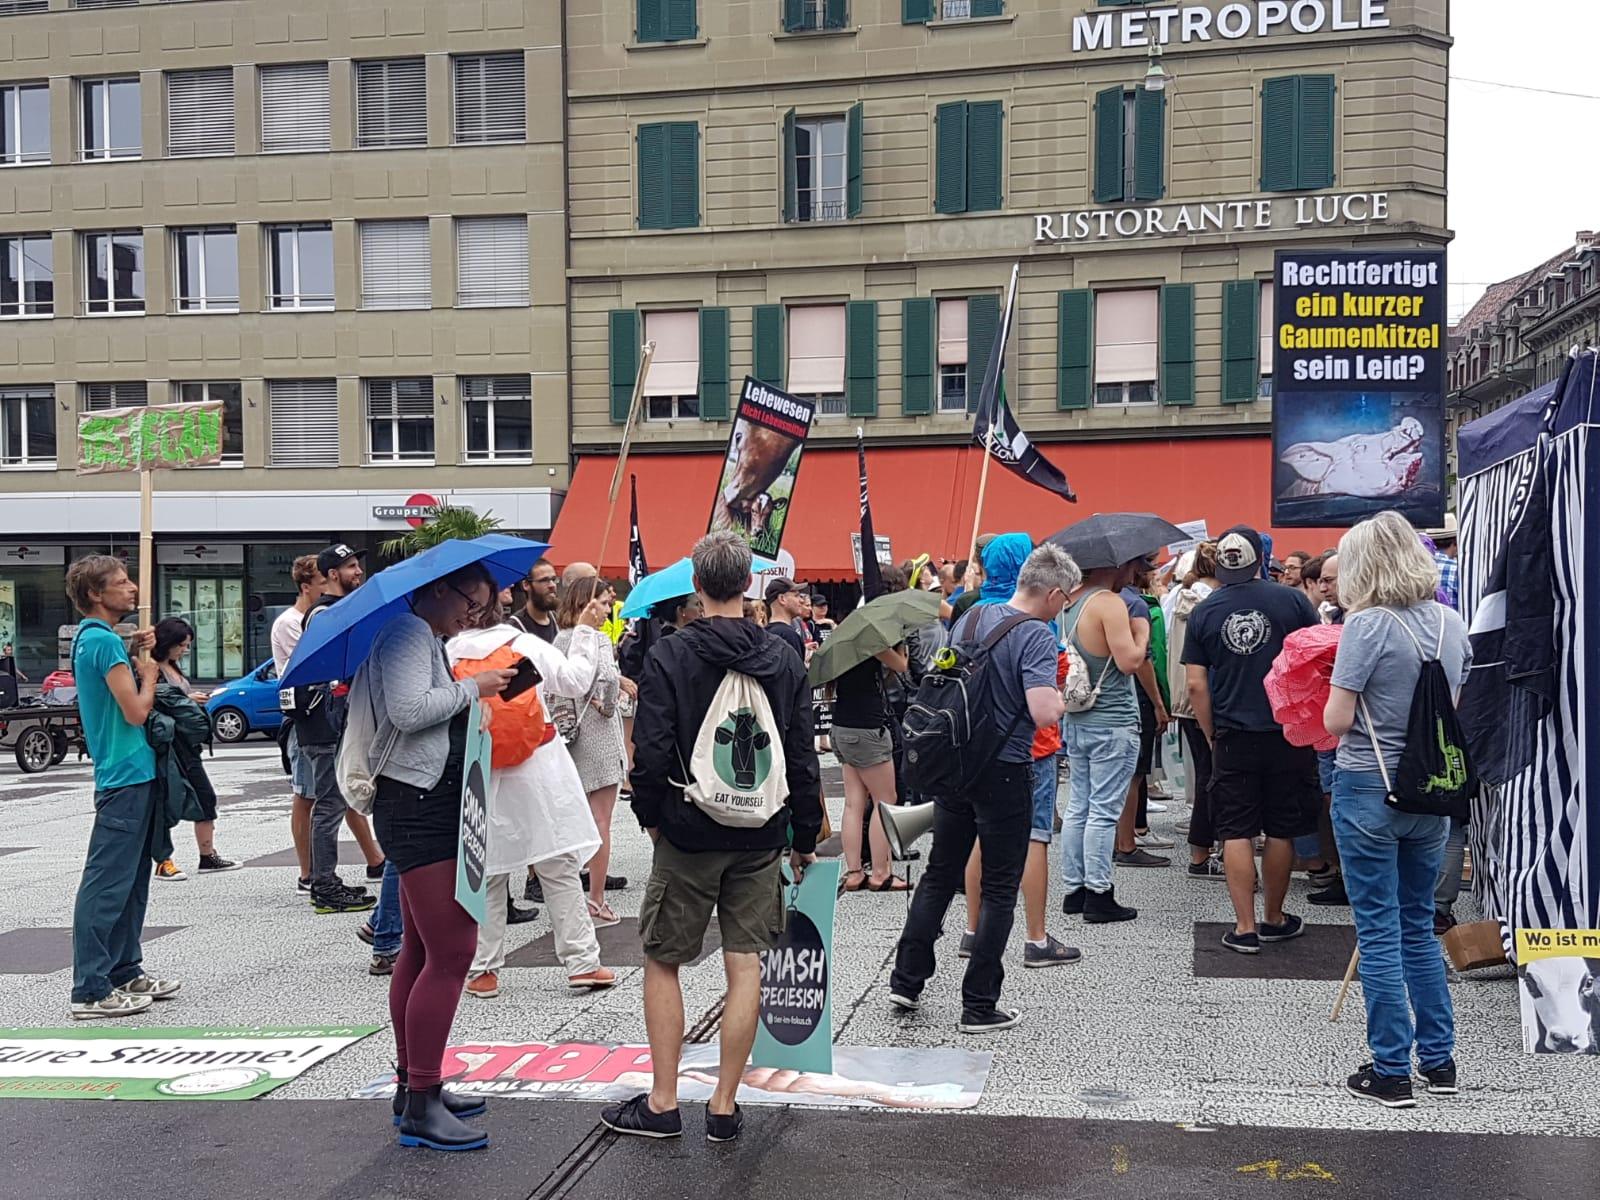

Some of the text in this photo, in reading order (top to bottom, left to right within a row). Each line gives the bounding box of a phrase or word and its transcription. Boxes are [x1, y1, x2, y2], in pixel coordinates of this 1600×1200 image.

[1072, 0, 1390, 51] METROPOLE
[1034, 200, 1272, 241] RISTORANTE
[1295, 192, 1389, 224] LUCE
[1282, 260, 1438, 288] Rechtfertigt
[1295, 292, 1424, 317] ein kurzer
[1279, 323, 1439, 349] Gaumenkitzel
[1293, 354, 1425, 380] sein Leid?
[745, 381, 811, 423] Lebewesen
[375, 507, 418, 517] Groupe
[715, 793, 729, 803] EAT
[1525, 932, 1551, 946] Wo
[1556, 932, 1577, 946] ist
[760, 948, 825, 985] SMASH
[90, 1045, 323, 1065] Stimme!
[522, 1082, 606, 1093] ABUSE
